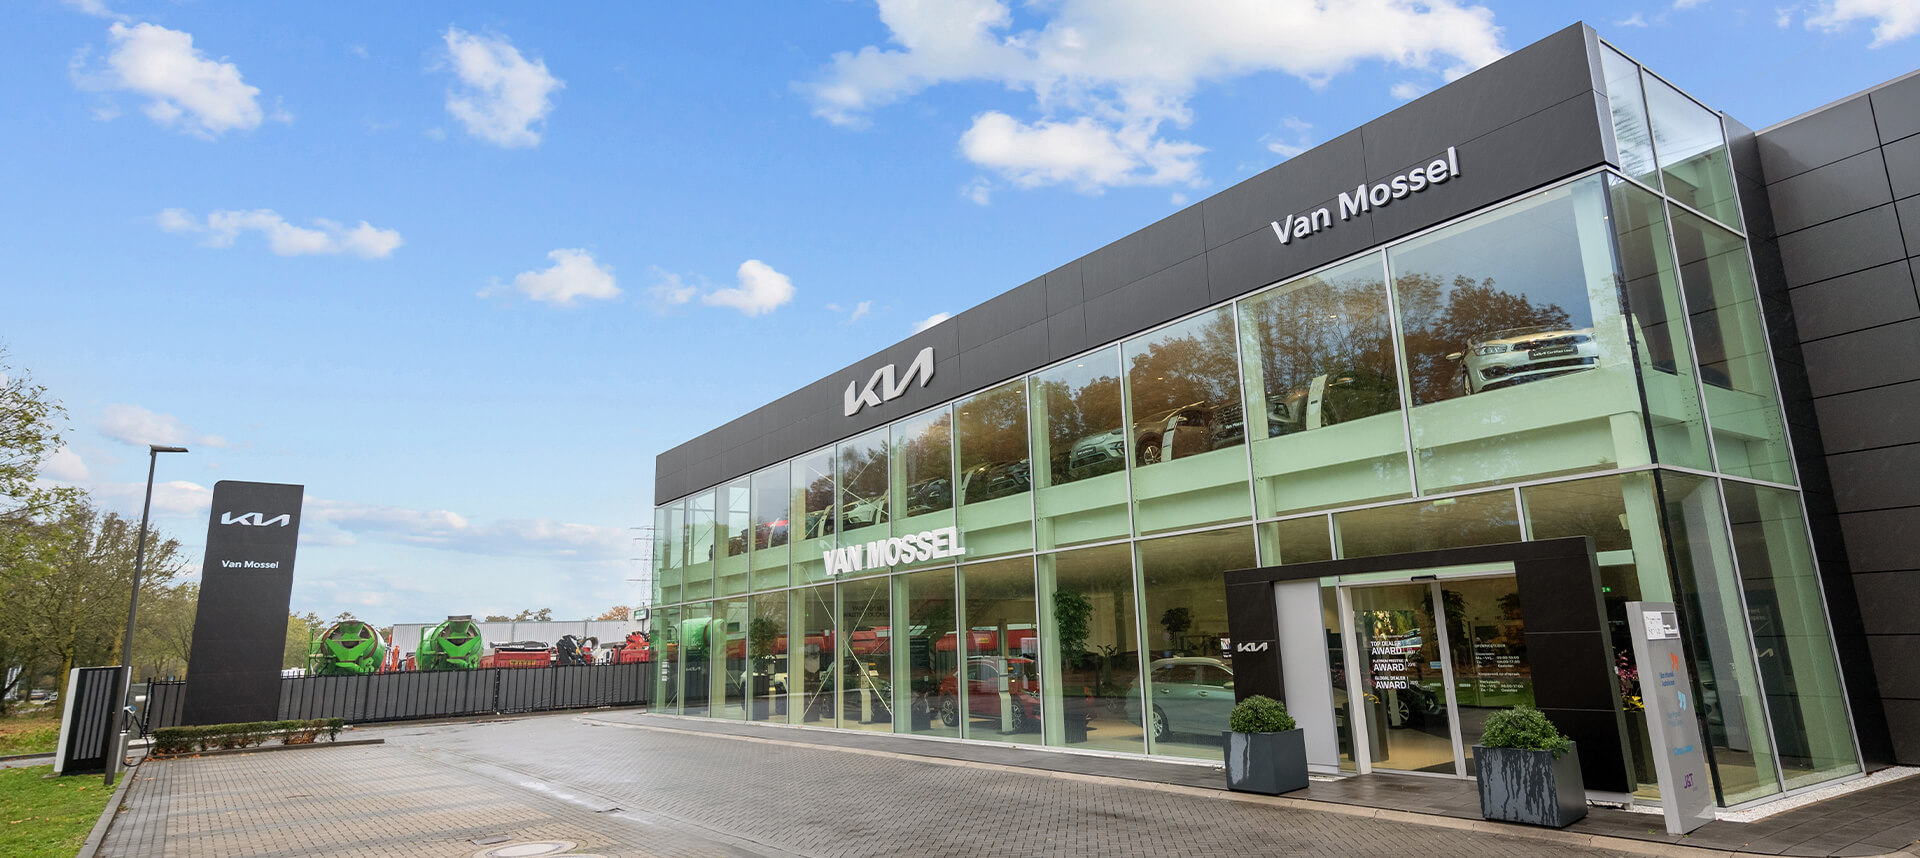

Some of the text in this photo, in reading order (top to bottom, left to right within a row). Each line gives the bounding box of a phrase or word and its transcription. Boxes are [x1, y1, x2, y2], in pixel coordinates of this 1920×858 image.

[1271, 146, 1460, 244] Van Mossel
[844, 346, 934, 417] KIA
[221, 511, 291, 528] KIA
[823, 526, 966, 576] VAN MOSSEL
[221, 560, 280, 569] Van Mossel
[1237, 642, 1268, 653] KIA
[1371, 647, 1402, 655] AWARD
[1373, 663, 1405, 671] AWARD
[1375, 681, 1407, 689] AWARD
